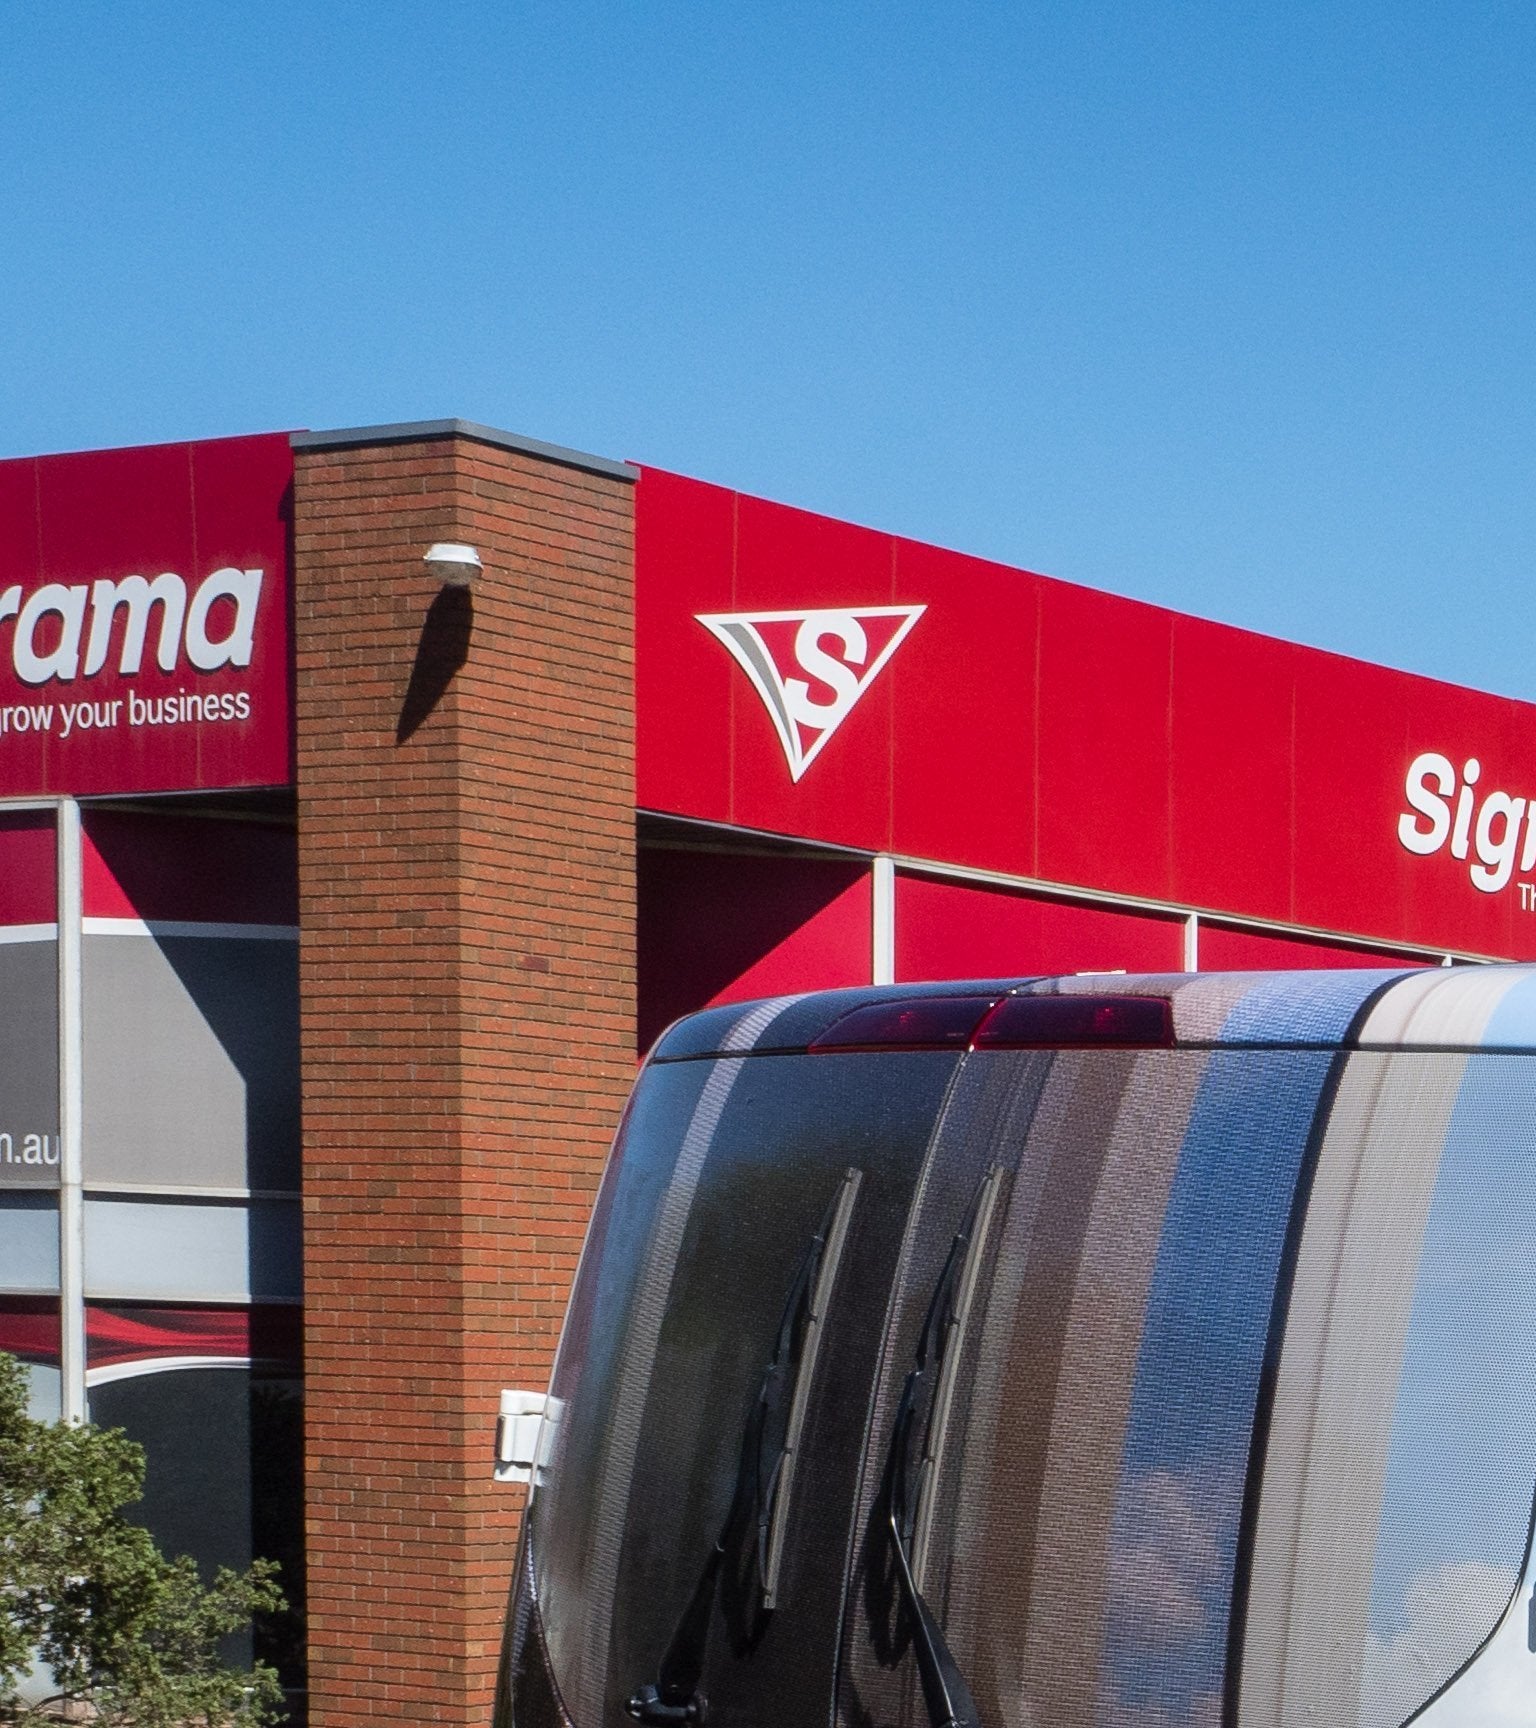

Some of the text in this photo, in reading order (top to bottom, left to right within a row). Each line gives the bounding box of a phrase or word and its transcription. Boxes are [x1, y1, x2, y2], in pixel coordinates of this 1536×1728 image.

[0, 688, 250, 738] row your business
